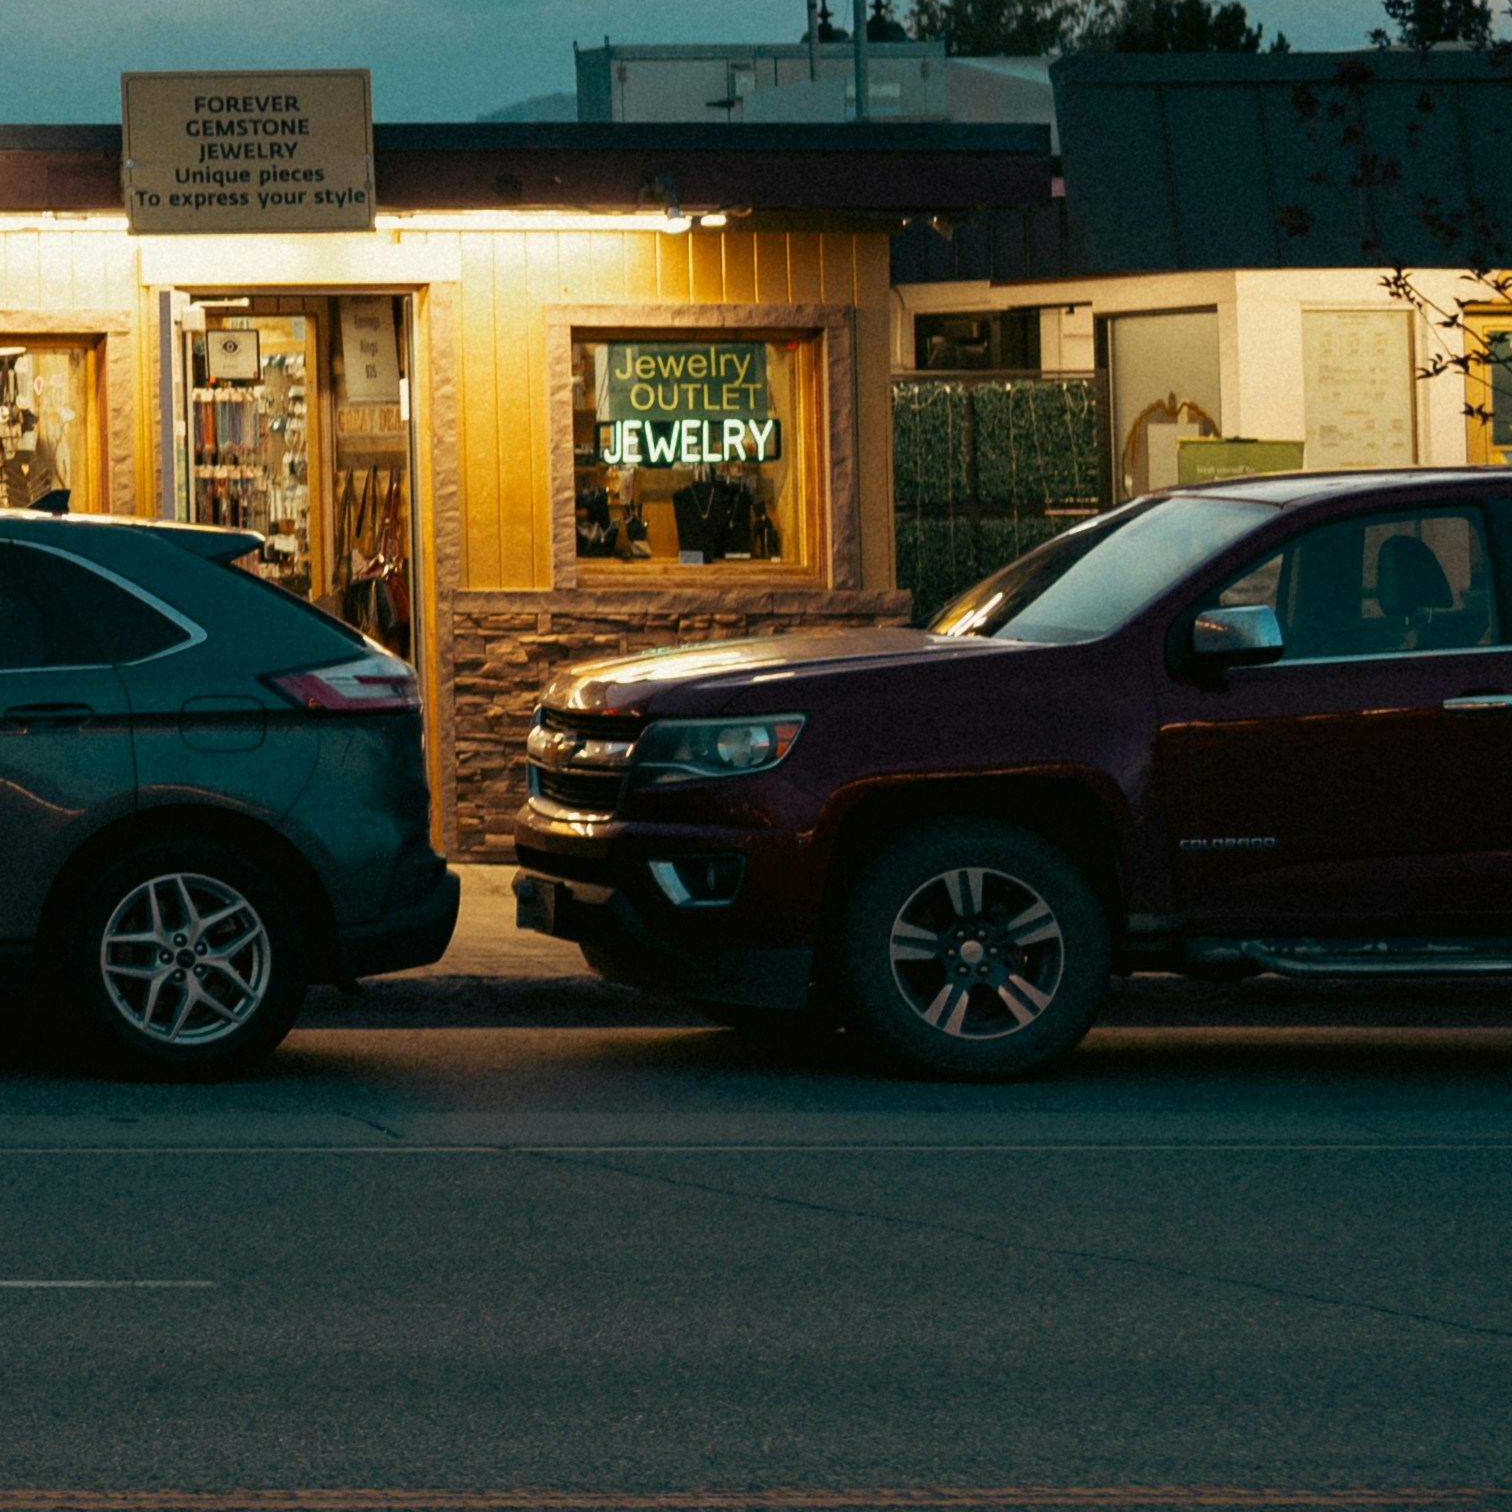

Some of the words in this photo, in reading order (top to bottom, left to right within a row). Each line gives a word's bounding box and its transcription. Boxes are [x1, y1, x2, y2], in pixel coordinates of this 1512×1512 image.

[194, 95, 301, 114] FOREVER
[185, 118, 310, 137] GEMSTONE
[198, 141, 299, 164] JEWELRY
[174, 165, 251, 188] Unique
[259, 163, 325, 187] pieces
[135, 190, 160, 206] To
[169, 190, 250, 211] express
[257, 190, 307, 210] your
[313, 186, 368, 209] style
[614, 345, 752, 387] Jewelry
[629, 383, 762, 411] OUTLET
[602, 418, 775, 465] JEWELRY
[1180, 838, 1276, 850] COLORADO
